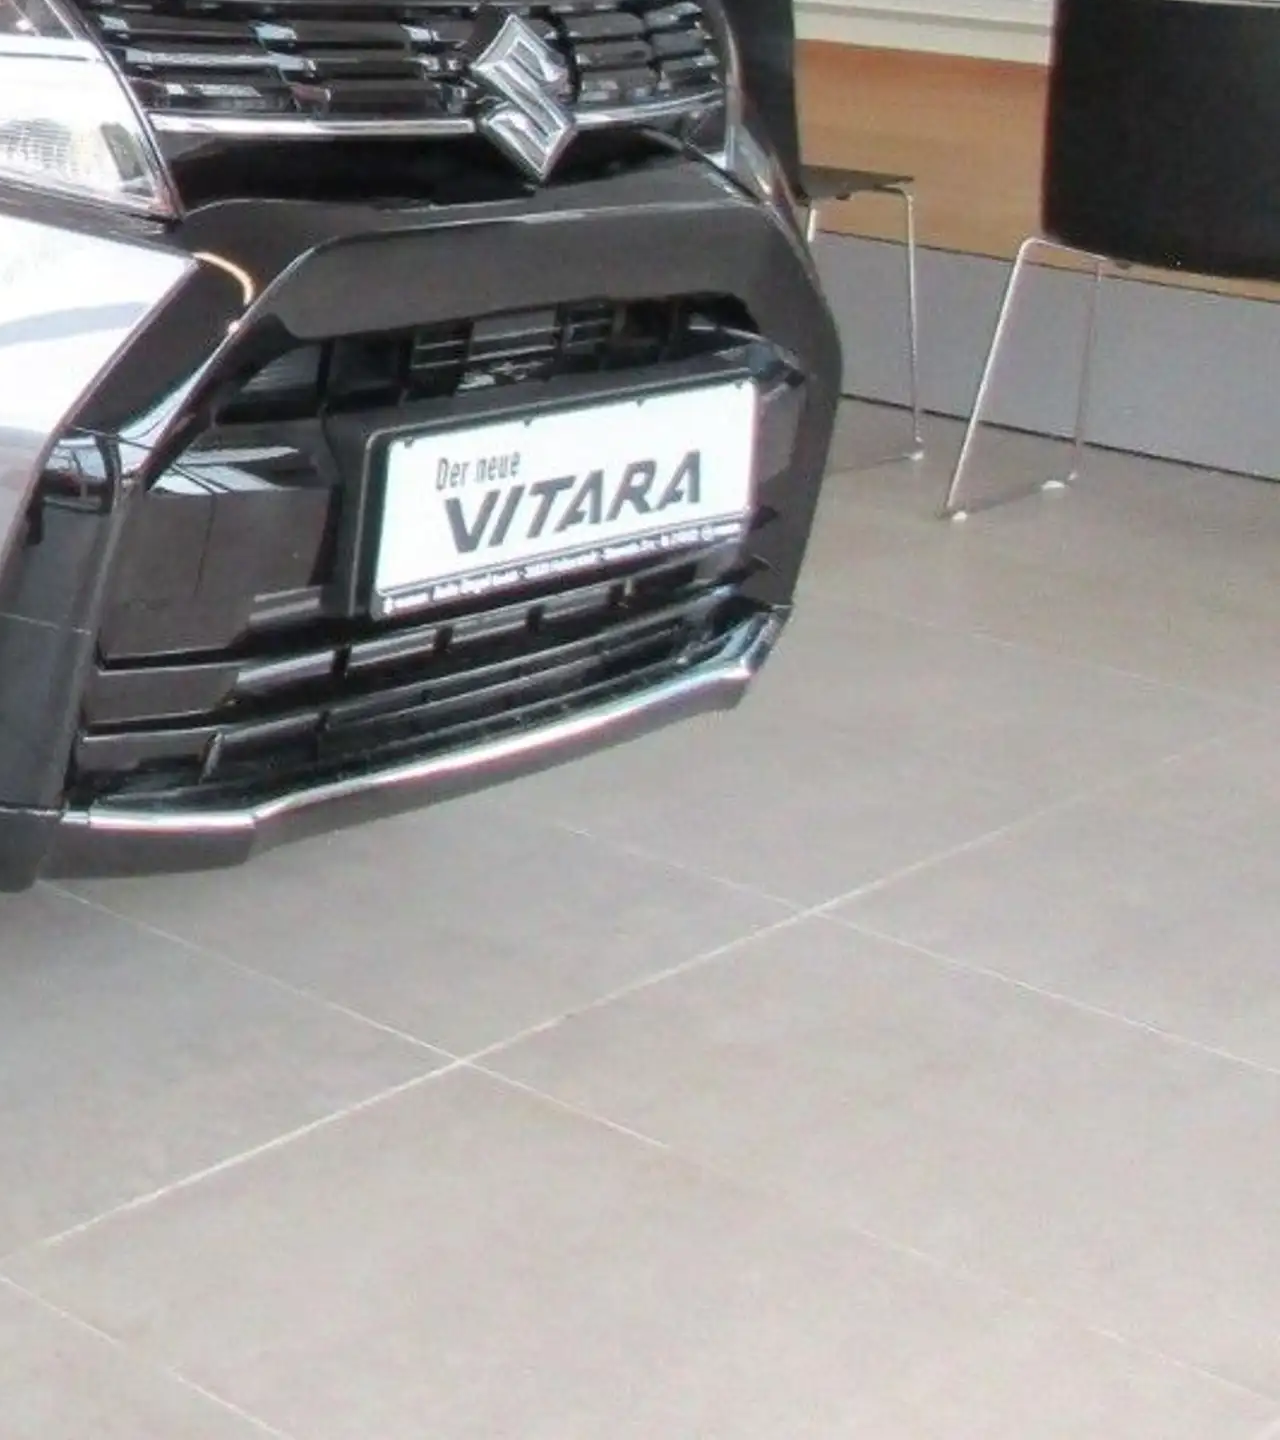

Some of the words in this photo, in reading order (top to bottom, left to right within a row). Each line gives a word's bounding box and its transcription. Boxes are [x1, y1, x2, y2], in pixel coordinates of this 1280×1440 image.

[435, 457, 470, 490] Der
[476, 451, 521, 482] neue
[445, 449, 698, 554] VITARA
